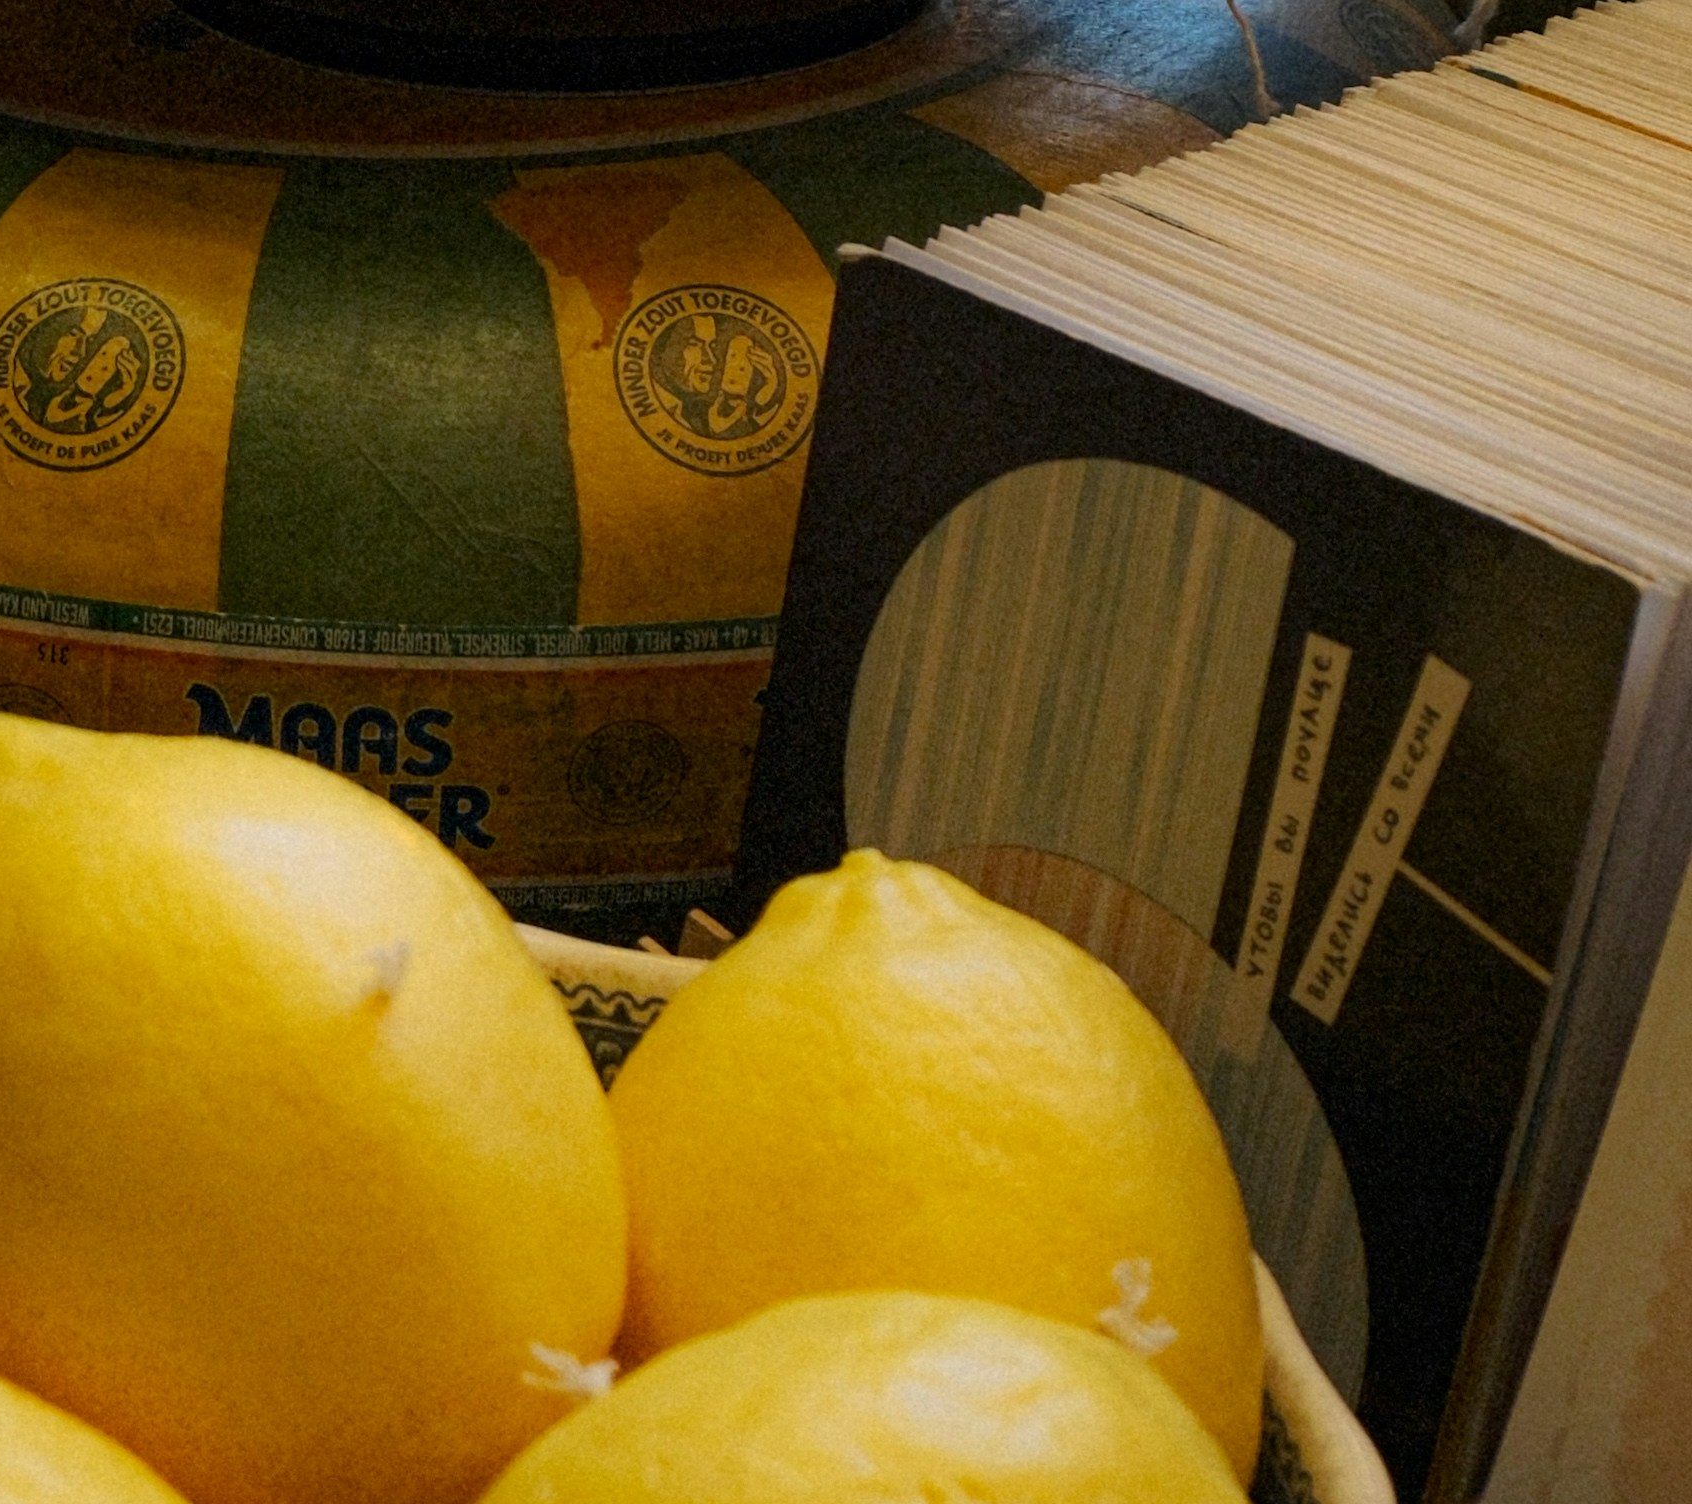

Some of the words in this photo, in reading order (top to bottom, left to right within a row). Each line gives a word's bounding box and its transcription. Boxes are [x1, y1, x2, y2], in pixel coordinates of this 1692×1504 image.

[32, 285, 90, 317] ZOUT
[98, 285, 176, 392] TOEGEVOEGD
[635, 297, 686, 336] ZOUT
[688, 291, 812, 379] TOEGEVOEGD
[623, 336, 657, 418] MINDER
[3, 416, 53, 455] PROEFT
[56, 443, 75, 459] DE
[80, 435, 120, 458] PURE
[121, 402, 157, 442] KAAS
[674, 440, 732, 465] PROEFT
[788, 392, 810, 439] KAAS
[19, 595, 90, 625] WESTLAND
[36, 642, 69, 665] 315
[186, 683, 453, 774] MAAS
